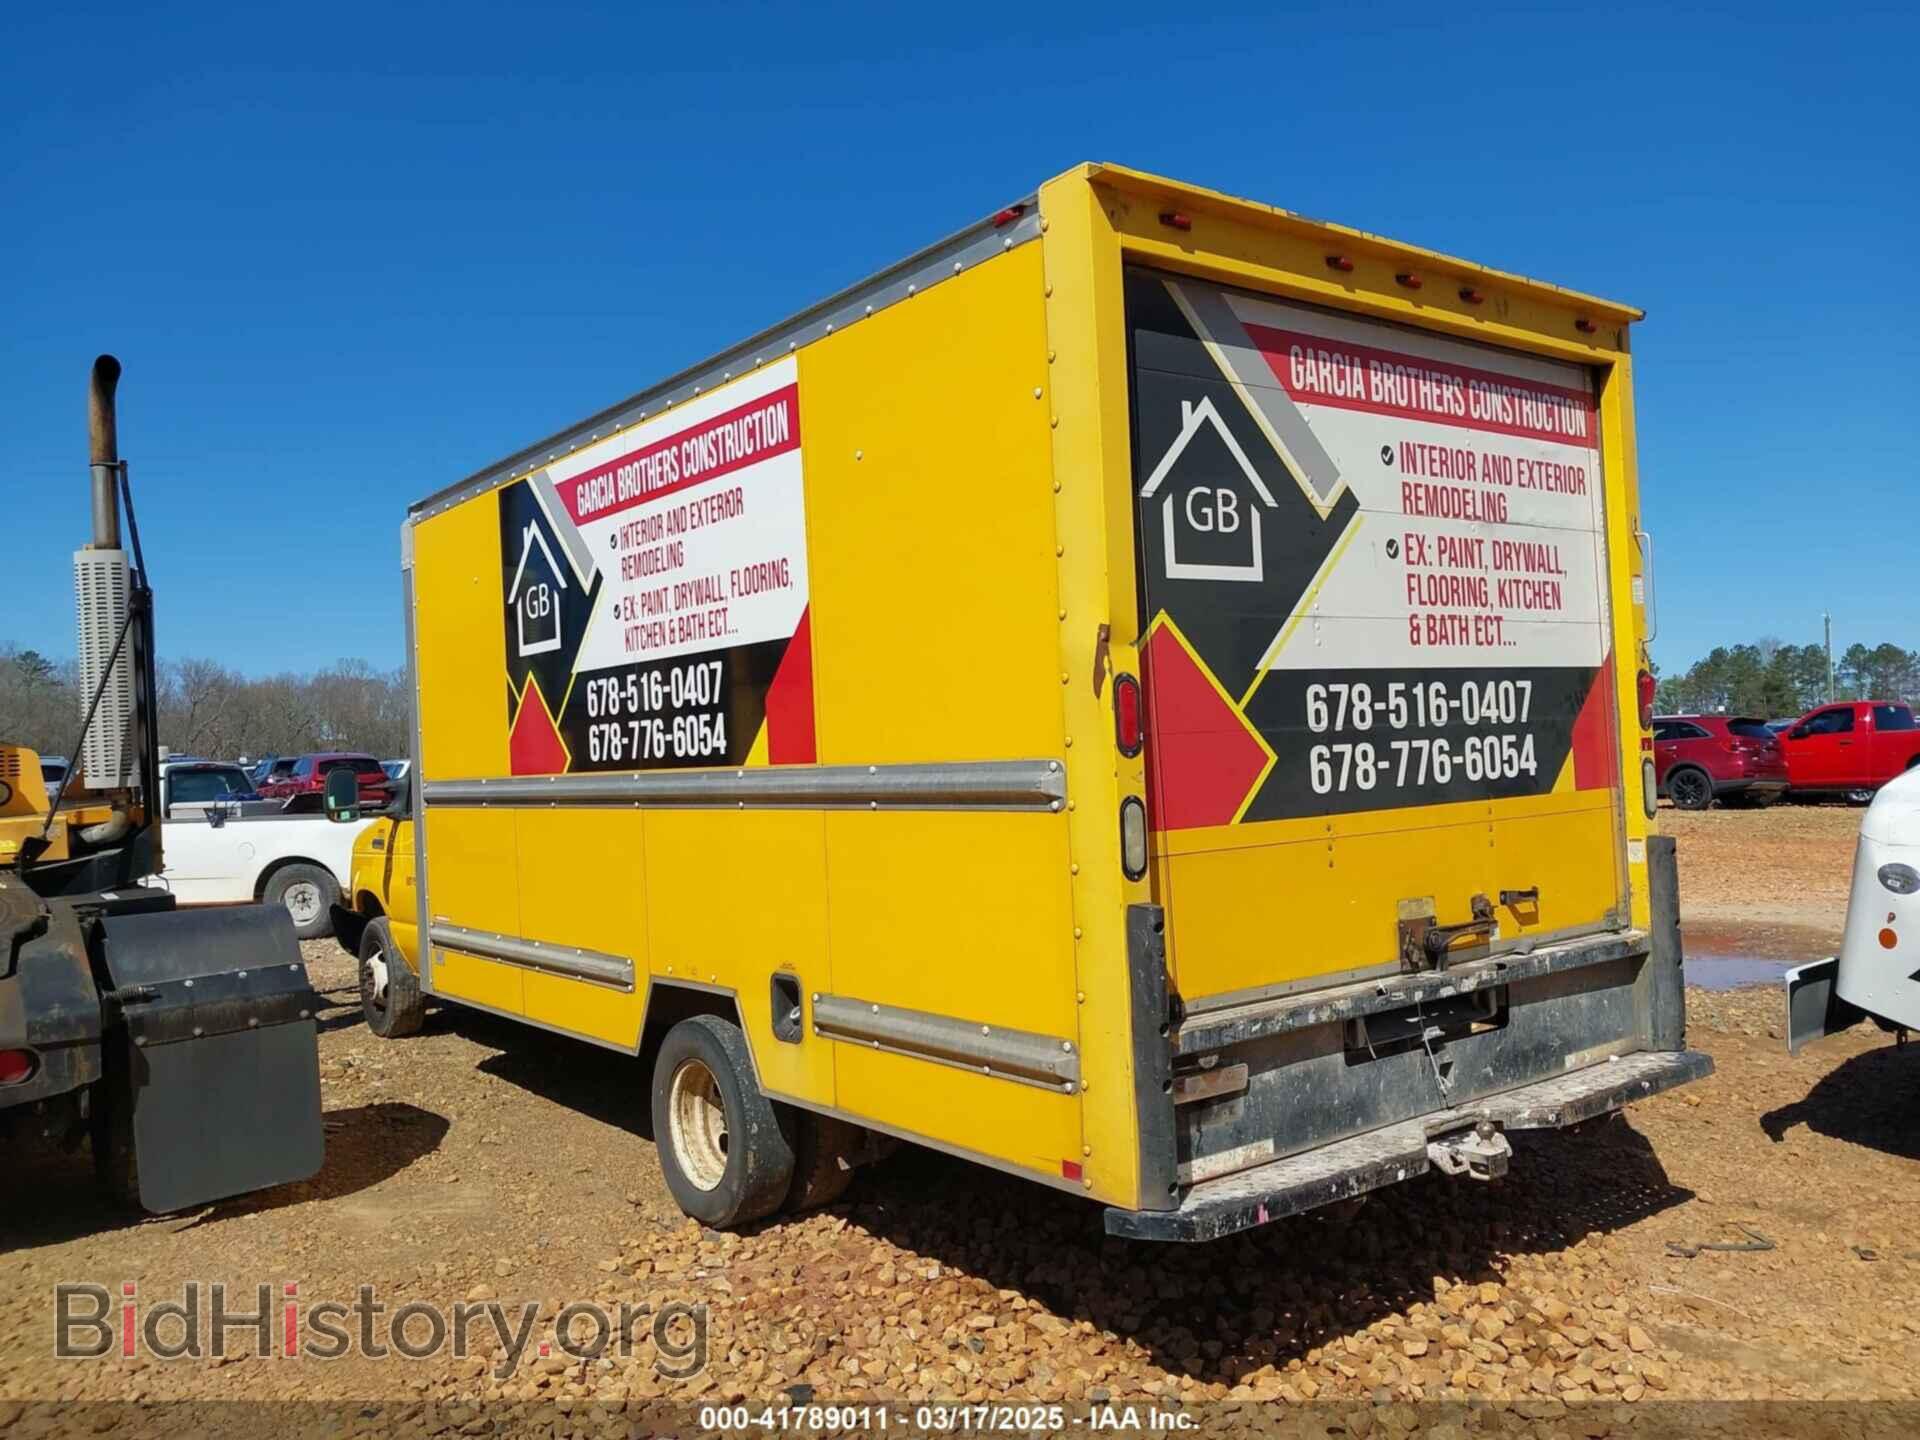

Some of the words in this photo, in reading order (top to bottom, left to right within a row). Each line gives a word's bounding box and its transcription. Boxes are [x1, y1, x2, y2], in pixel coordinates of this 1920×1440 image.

[1290, 345, 1364, 400] GARCIA
[1370, 360, 1466, 417] BROTHERS
[1469, 379, 1588, 438] CONSTRUCTION
[576, 471, 616, 516] GARCIA
[617, 446, 679, 503] BROTHERS
[682, 400, 789, 478] CONSTRUCTION
[1399, 441, 1476, 482] INTERIOR
[1482, 453, 1514, 486] AND
[1516, 458, 1587, 496] EXTERIOR
[619, 514, 664, 550] INTERIOR
[667, 505, 687, 536] AND
[690, 487, 744, 525] EXTERIOR
[1186, 485, 1240, 533] GB
[1402, 482, 1508, 524] REMODELING
[621, 548, 684, 582] REMODELING
[1404, 534, 1433, 566] EX:
[1437, 535, 1489, 575] PAINT,
[1492, 540, 1568, 578] DRYWALL,
[526, 583, 550, 620] GB
[623, 596, 640, 622] EX:
[640, 587, 672, 620] PAINT,
[674, 573, 728, 611] DRYWALL,
[730, 557, 793, 597] FLOORING,
[1407, 574, 1494, 611] FLOORING,
[1497, 579, 1562, 611] KITCHEN
[625, 621, 666, 652] KITCHEN
[668, 618, 676, 645] &
[678, 612, 705, 644] BATH
[1409, 614, 1422, 646] &
[1427, 614, 1470, 647] BATH
[1475, 615, 1517, 647] ECT...
[587, 661, 723, 718] 678-516-0407
[1305, 680, 1533, 733] 678-516-0407
[589, 713, 727, 762] 678-776-6054
[1309, 734, 1538, 795] 678-776-6054
